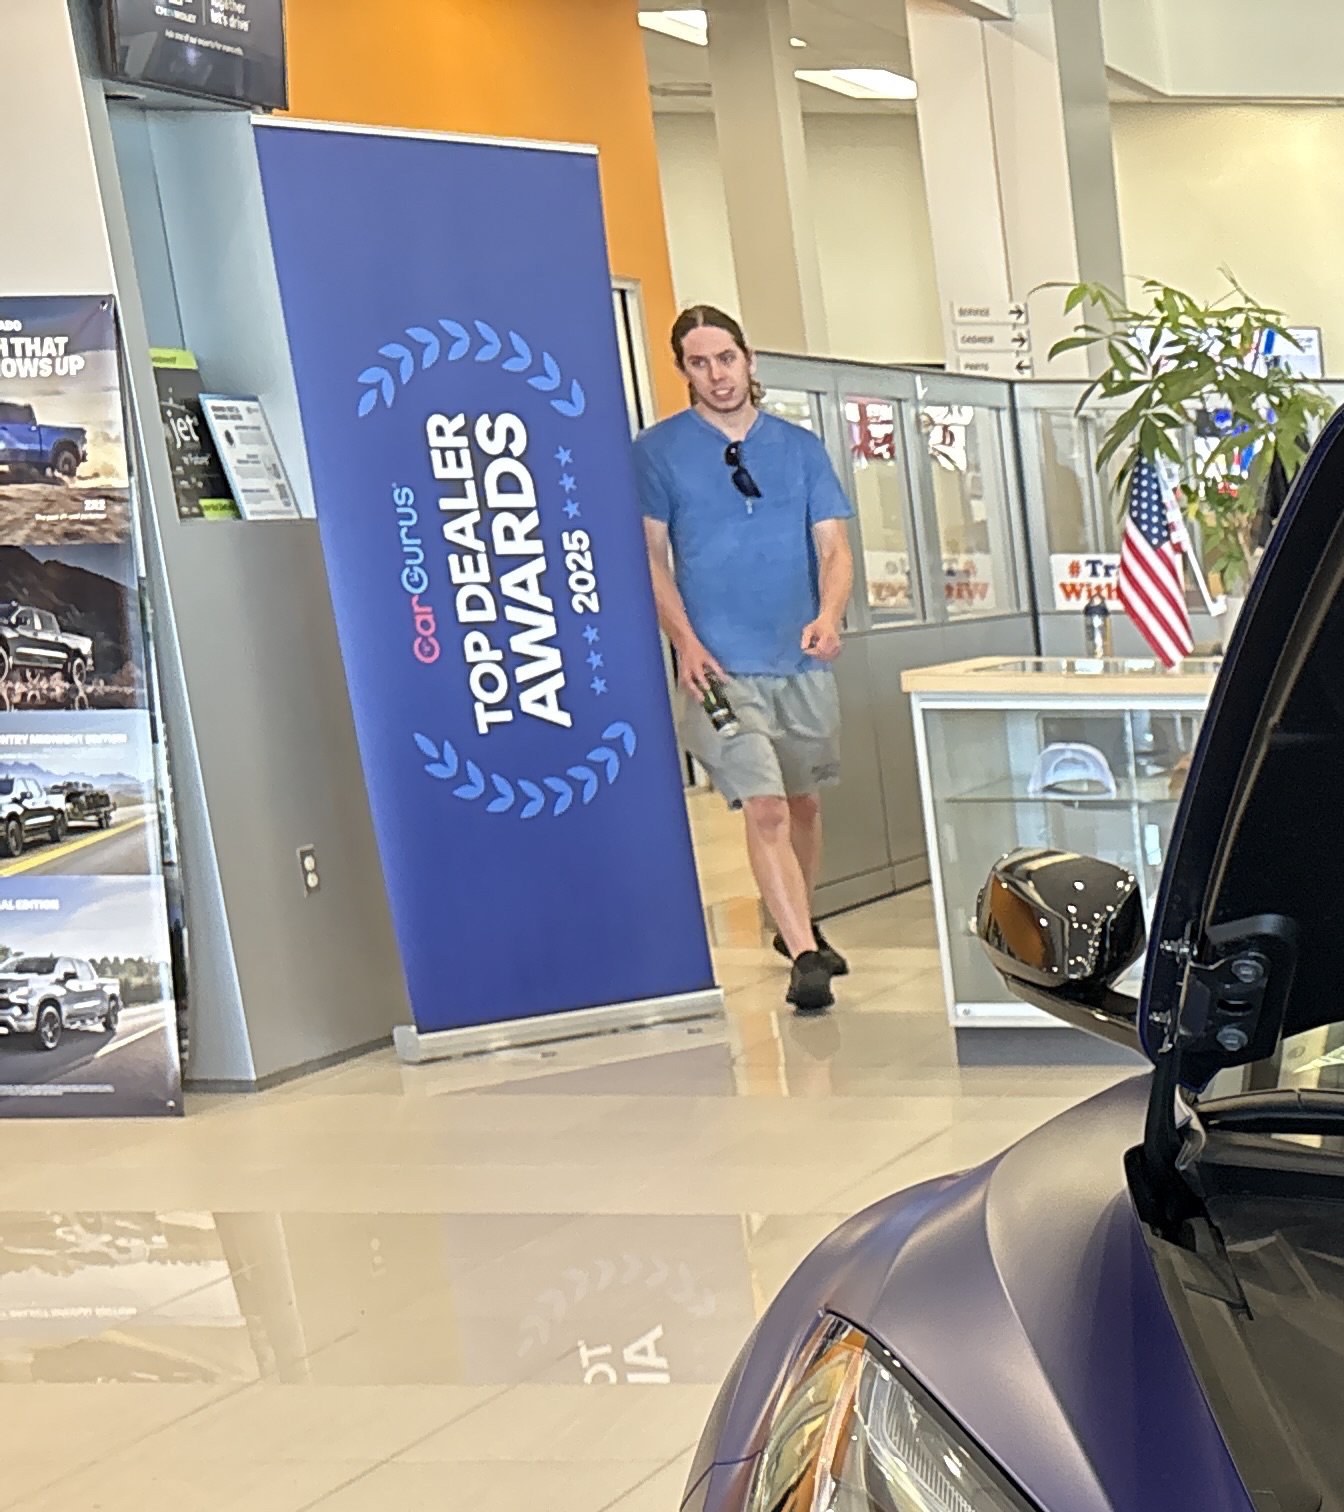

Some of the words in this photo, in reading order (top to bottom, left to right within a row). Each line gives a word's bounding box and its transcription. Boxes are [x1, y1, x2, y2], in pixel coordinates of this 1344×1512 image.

[0, 357, 53, 378] OWS
[54, 354, 86, 376] UP
[9, 336, 69, 357] THAT
[426, 412, 498, 624] DEALER
[473, 410, 573, 729] AWARDS
[395, 484, 440, 664] CarGurus
[562, 528, 600, 615] 2025
[463, 630, 514, 735] TOP
